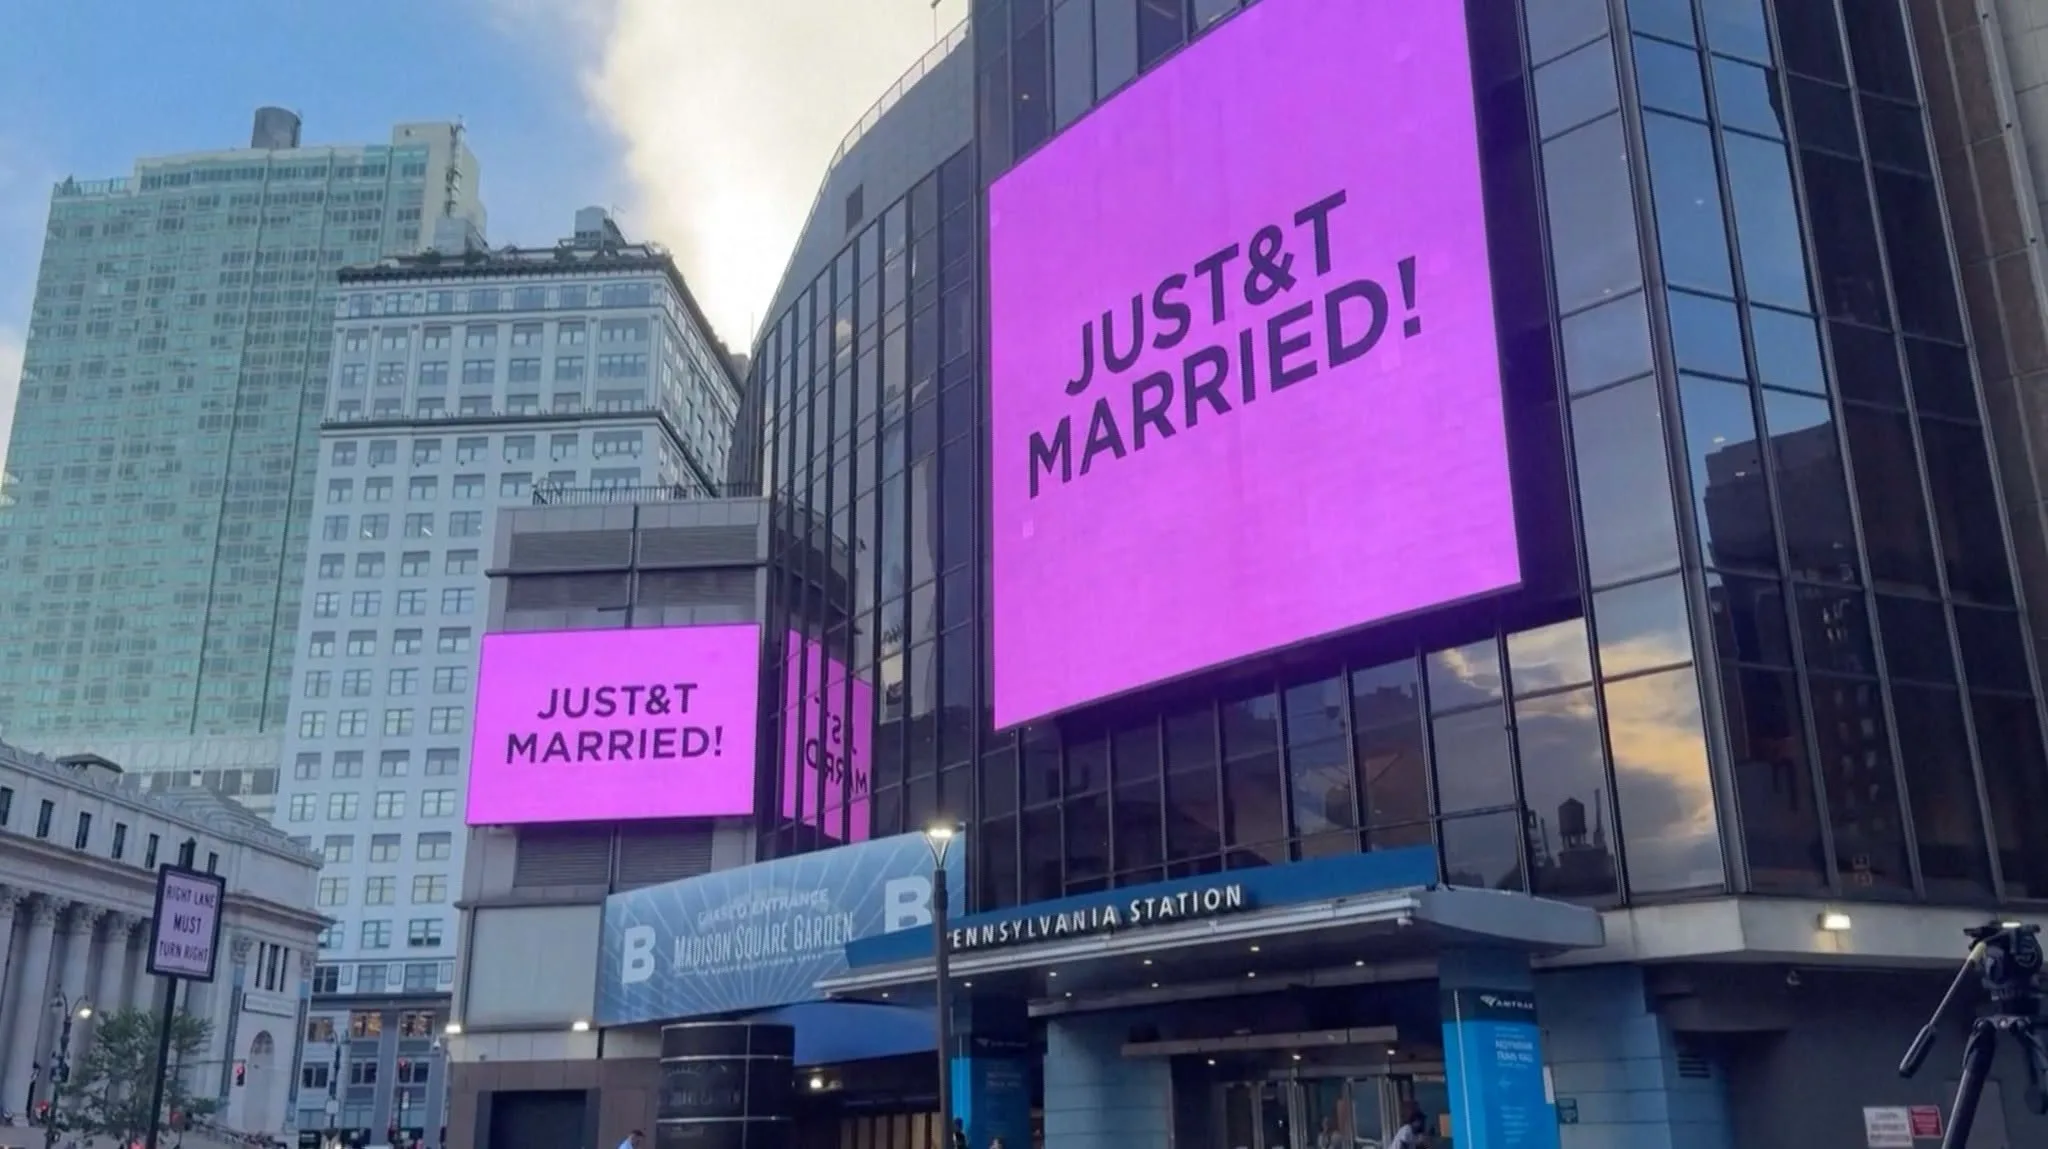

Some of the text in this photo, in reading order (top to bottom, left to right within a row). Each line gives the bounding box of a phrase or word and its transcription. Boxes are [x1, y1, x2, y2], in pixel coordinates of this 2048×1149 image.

[1065, 189, 1347, 397] JUST&T
[1029, 255, 1421, 500] MARRIED!
[537, 683, 698, 720] JUST&T
[506, 725, 723, 764] MARRIED!
[166, 885, 215, 909] RIGHT LANE
[751, 888, 828, 916] ENTRANCE
[884, 876, 932, 933] B
[948, 884, 1242, 948] ENNSYLVANIA STATION
[173, 912, 201, 934] MUST
[673, 931, 731, 969] MADISON
[735, 922, 788, 963] SQUARE
[793, 911, 854, 951] GARDEN
[160, 940, 208, 962] TURN RIGHT
[621, 924, 656, 984] B
